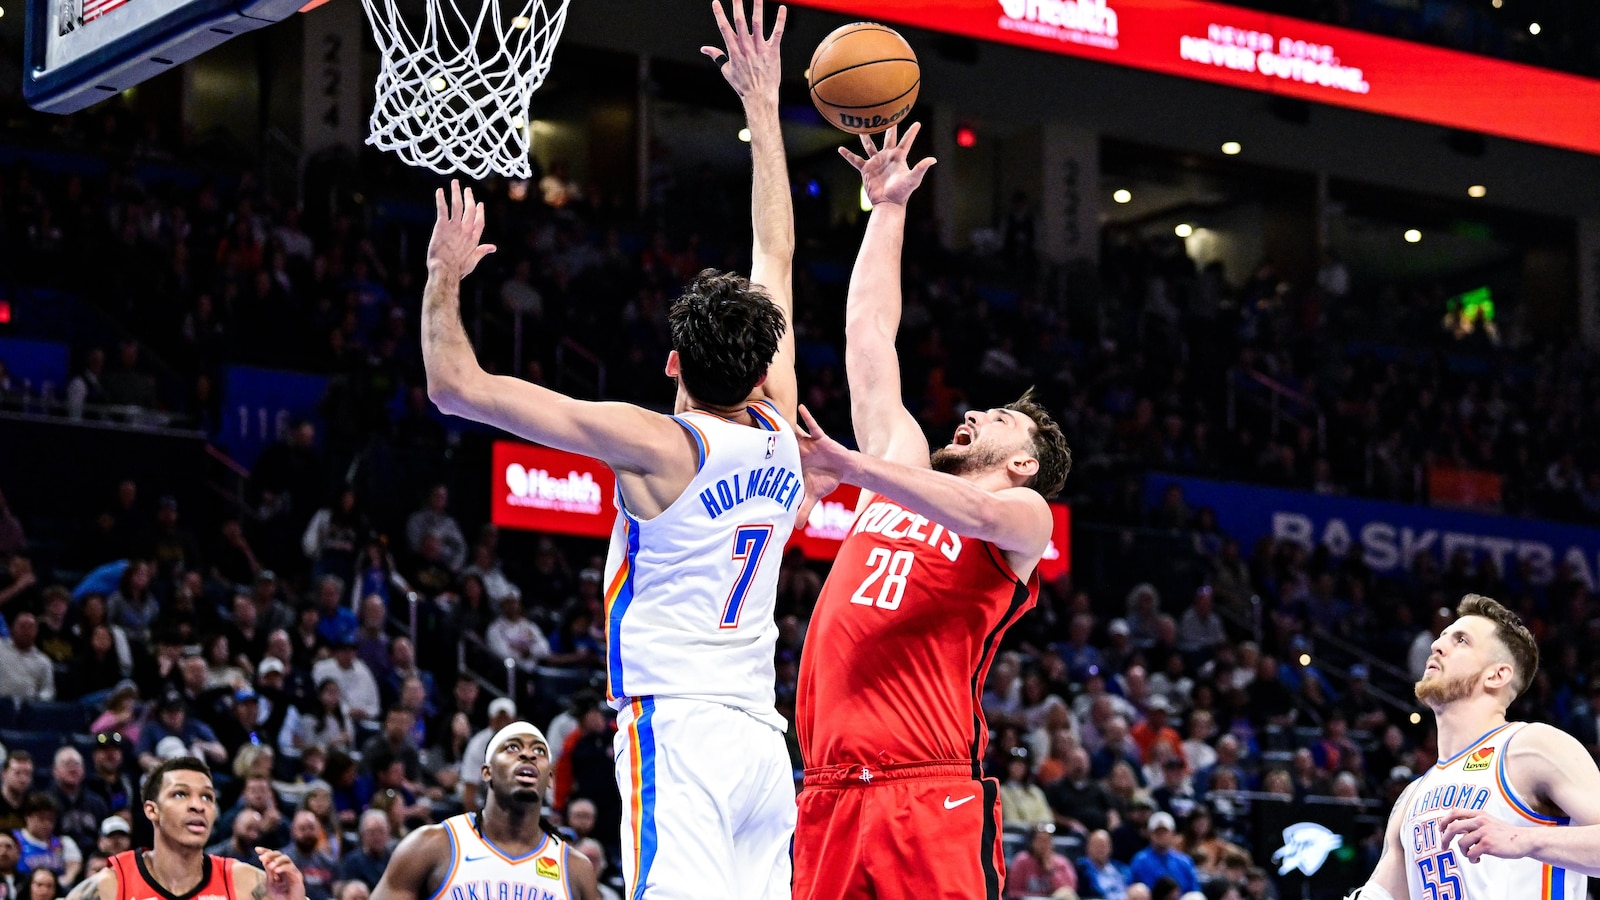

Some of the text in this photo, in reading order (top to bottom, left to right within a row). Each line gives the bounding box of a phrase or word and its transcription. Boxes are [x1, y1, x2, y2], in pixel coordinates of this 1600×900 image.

[1180, 35, 1256, 73] NEVER
[840, 104, 910, 129] Wilson
[699, 466, 801, 520] HOLMGREN
[853, 502, 962, 562] ROCETS
[1272, 511, 1600, 590] BASKETBA
[719, 524, 774, 629] 7
[850, 547, 915, 611] 28
[1413, 817, 1446, 854] CIT
[1415, 849, 1464, 900] 55
